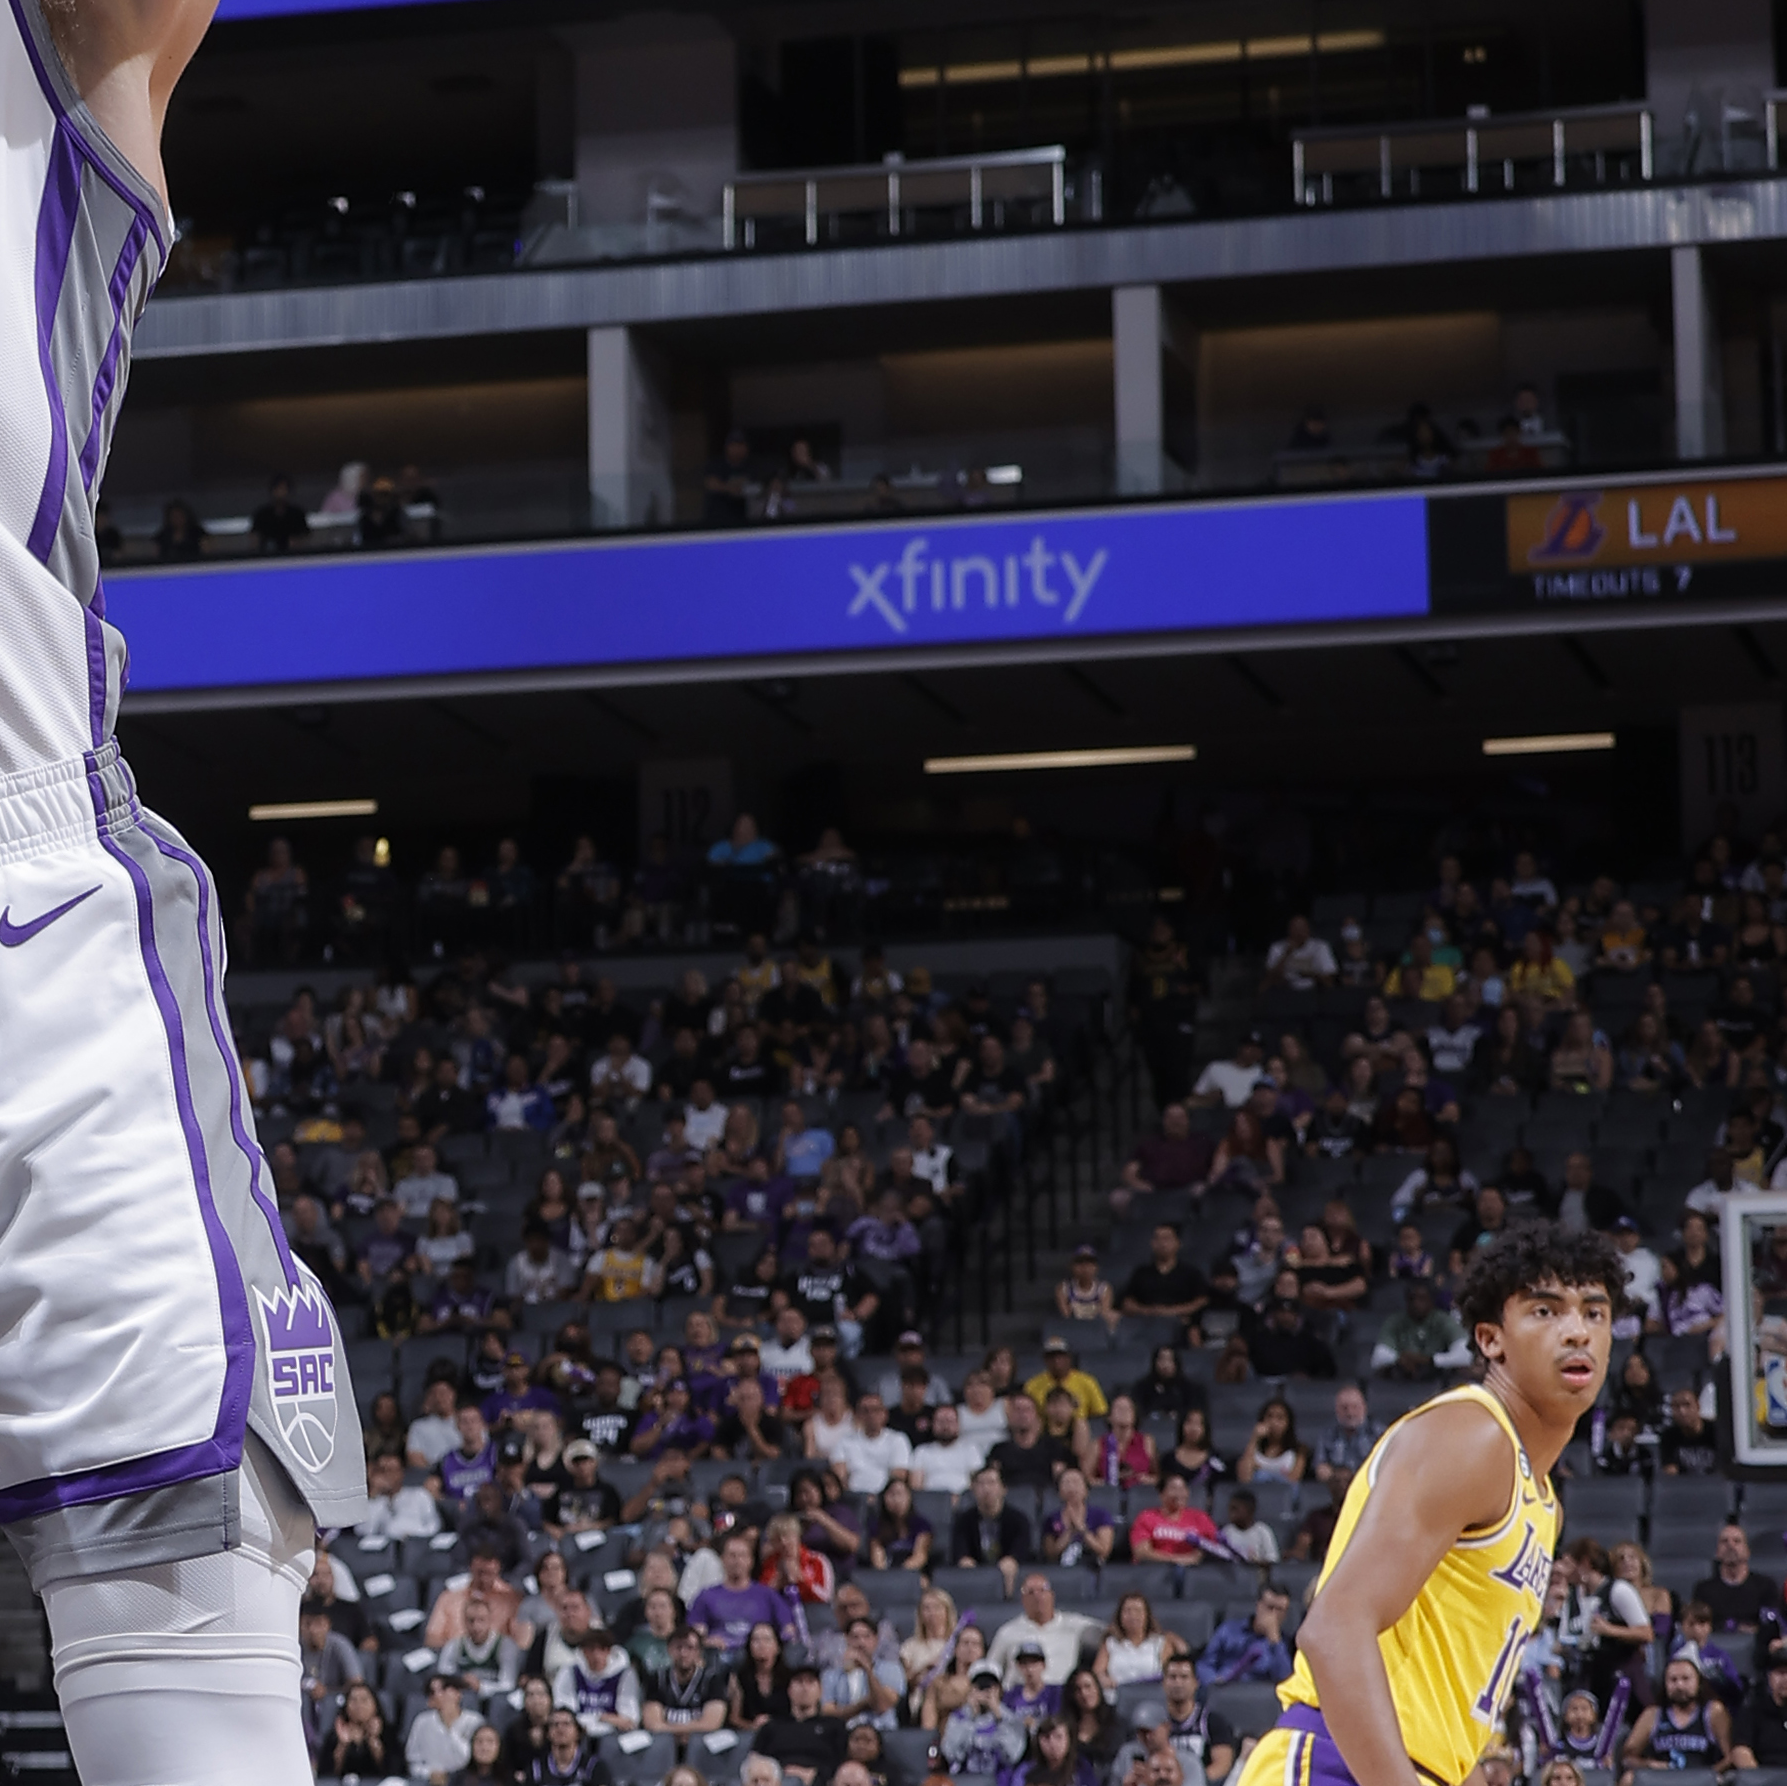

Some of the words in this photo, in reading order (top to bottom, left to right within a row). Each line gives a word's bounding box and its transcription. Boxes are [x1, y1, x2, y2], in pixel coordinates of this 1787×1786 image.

[1626, 493, 1738, 549] LAL
[846, 535, 1108, 634] xfinity
[1672, 565, 1692, 593] 7
[271, 1352, 335, 1398] SAC
